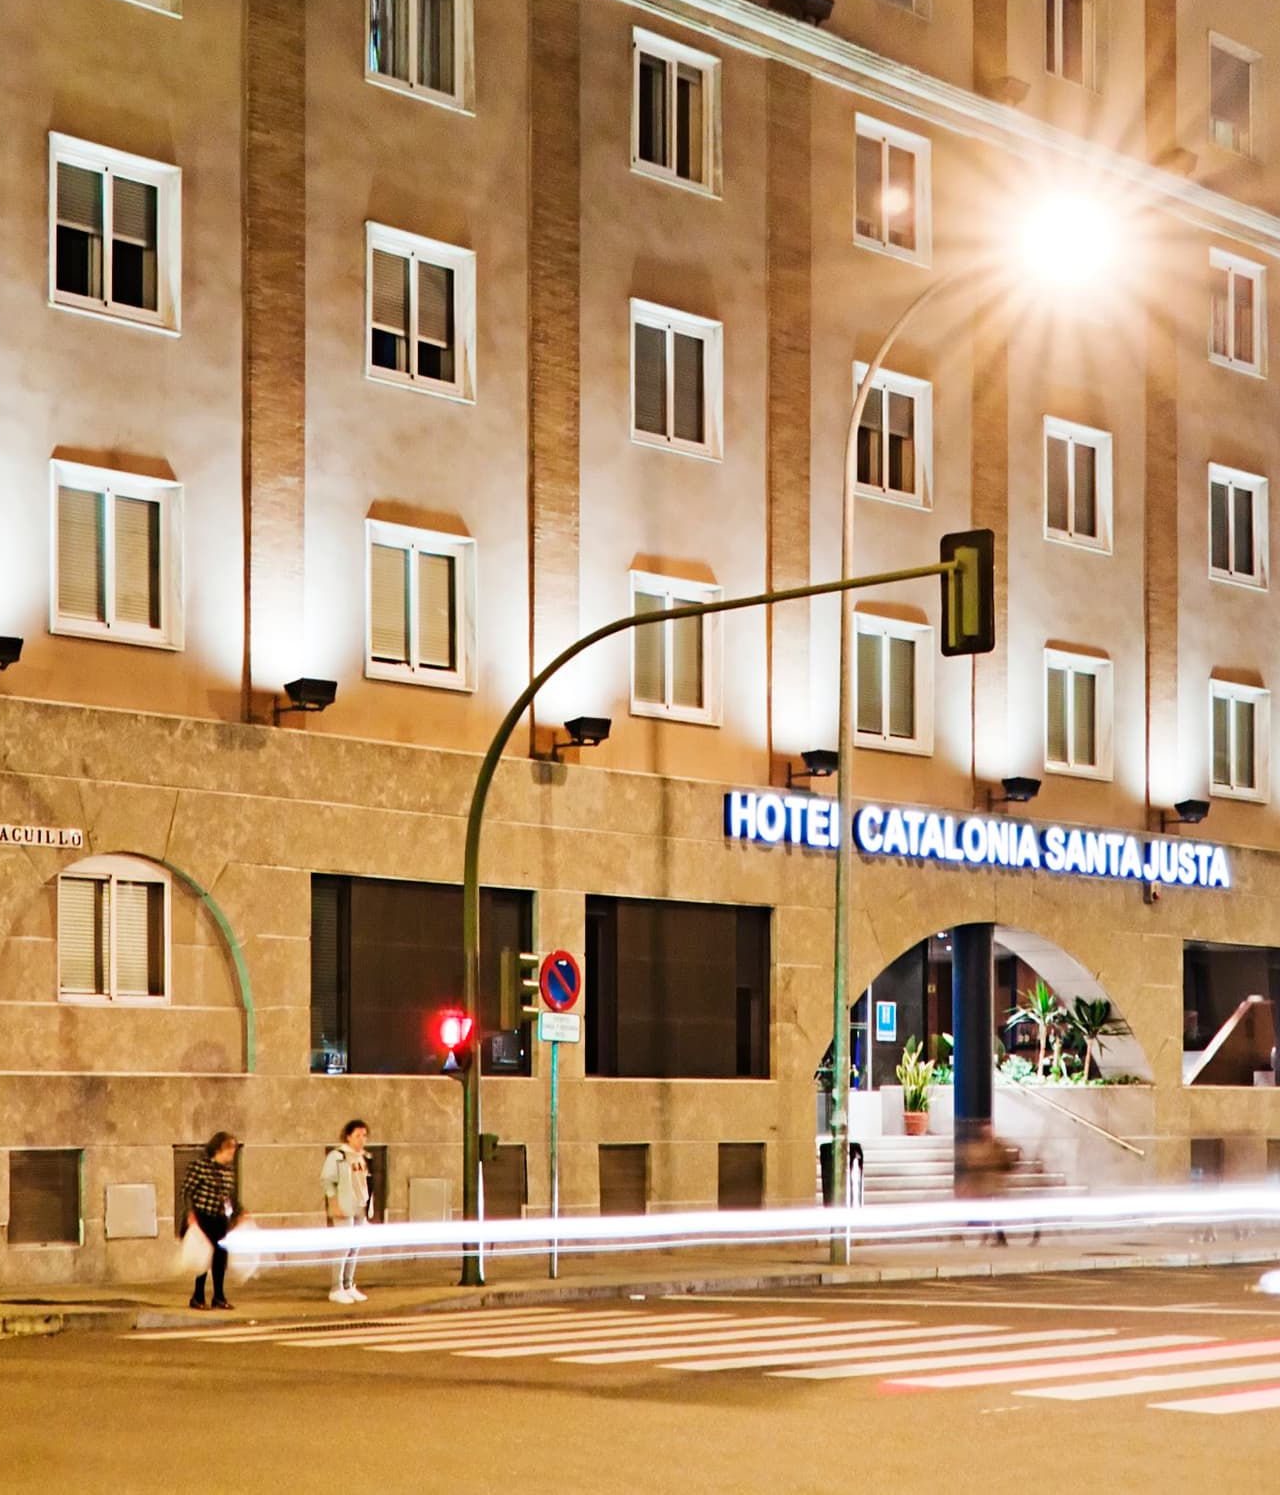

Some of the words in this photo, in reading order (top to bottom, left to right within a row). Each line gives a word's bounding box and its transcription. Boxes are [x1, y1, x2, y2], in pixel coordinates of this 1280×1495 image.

[858, 806, 1040, 869] CATALONIA
[1045, 827, 1142, 880] SANTA
[1143, 839, 1230, 888] JUSTA
